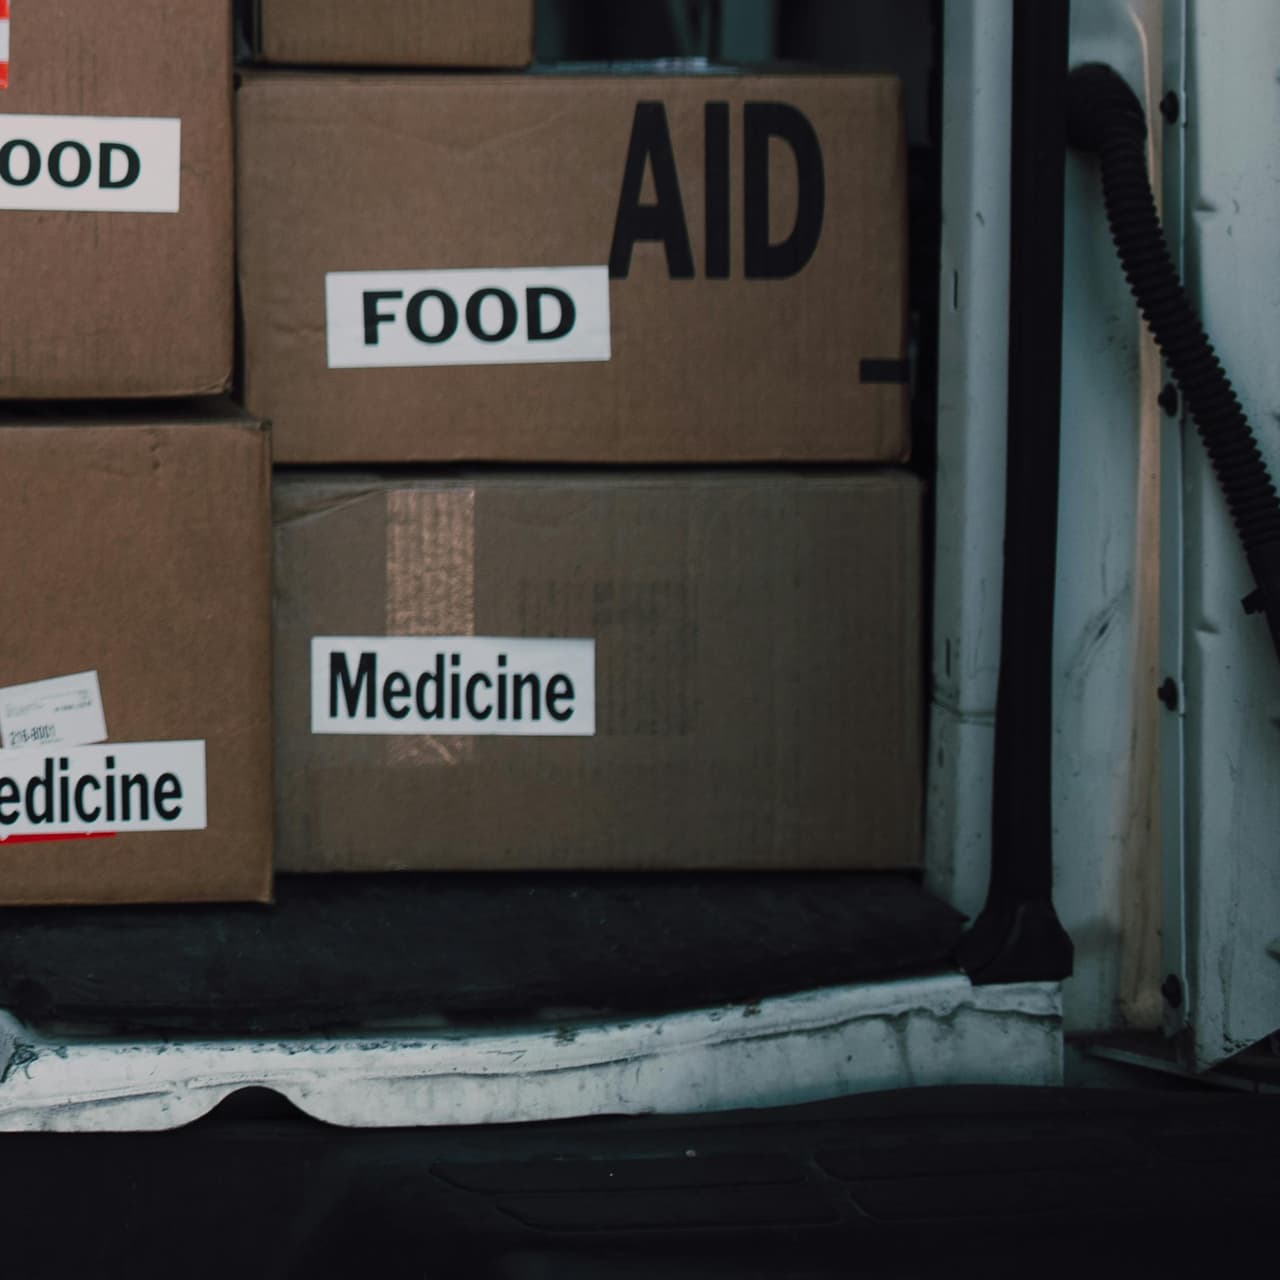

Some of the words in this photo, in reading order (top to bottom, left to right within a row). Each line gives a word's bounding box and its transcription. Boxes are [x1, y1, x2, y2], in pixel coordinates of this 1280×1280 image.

[608, 100, 827, 281] AID
[361, 286, 578, 346] FOOD
[328, 651, 576, 722] Medicine
